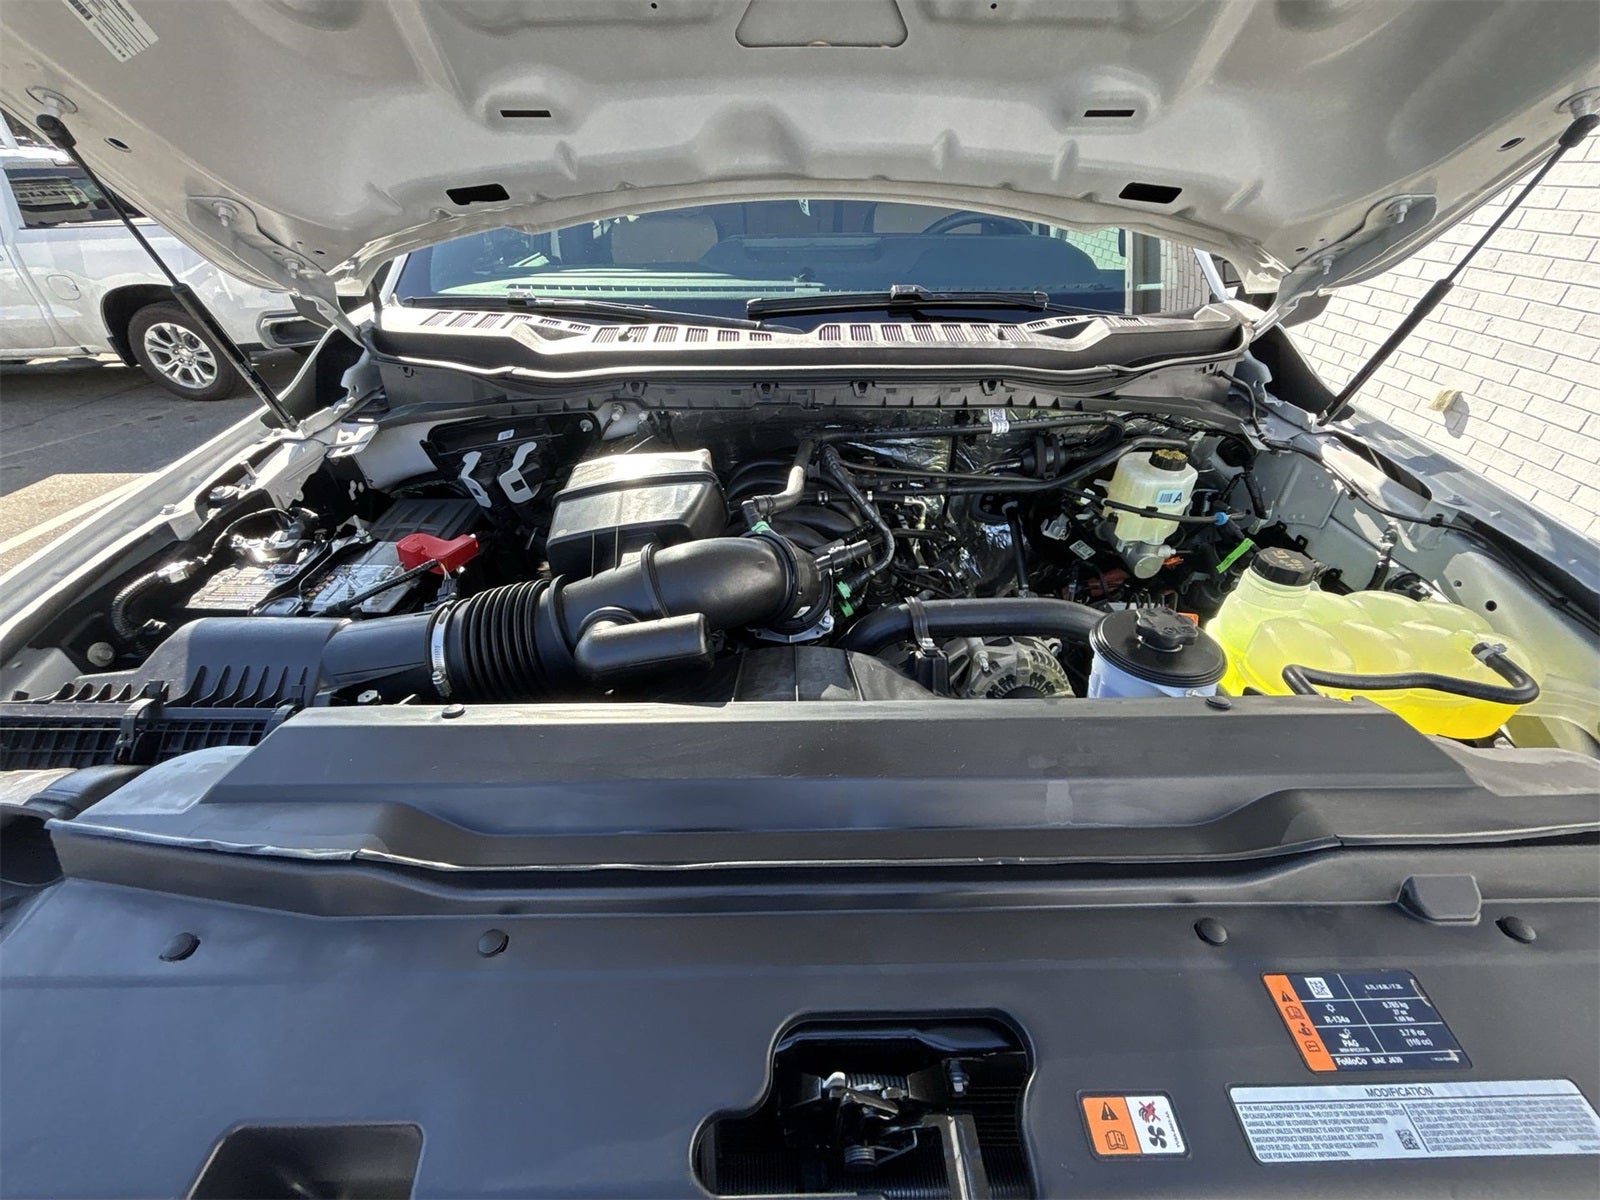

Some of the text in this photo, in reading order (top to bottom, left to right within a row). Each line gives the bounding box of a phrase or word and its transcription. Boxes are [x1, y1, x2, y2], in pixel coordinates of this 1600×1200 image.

[1323, 1015, 1351, 1024] R-134a
[1406, 1038, 1434, 1047] (110 cc)
[1336, 1057, 1368, 1066] FoMoCo
[1365, 1086, 1434, 1098] MODIFICATION
